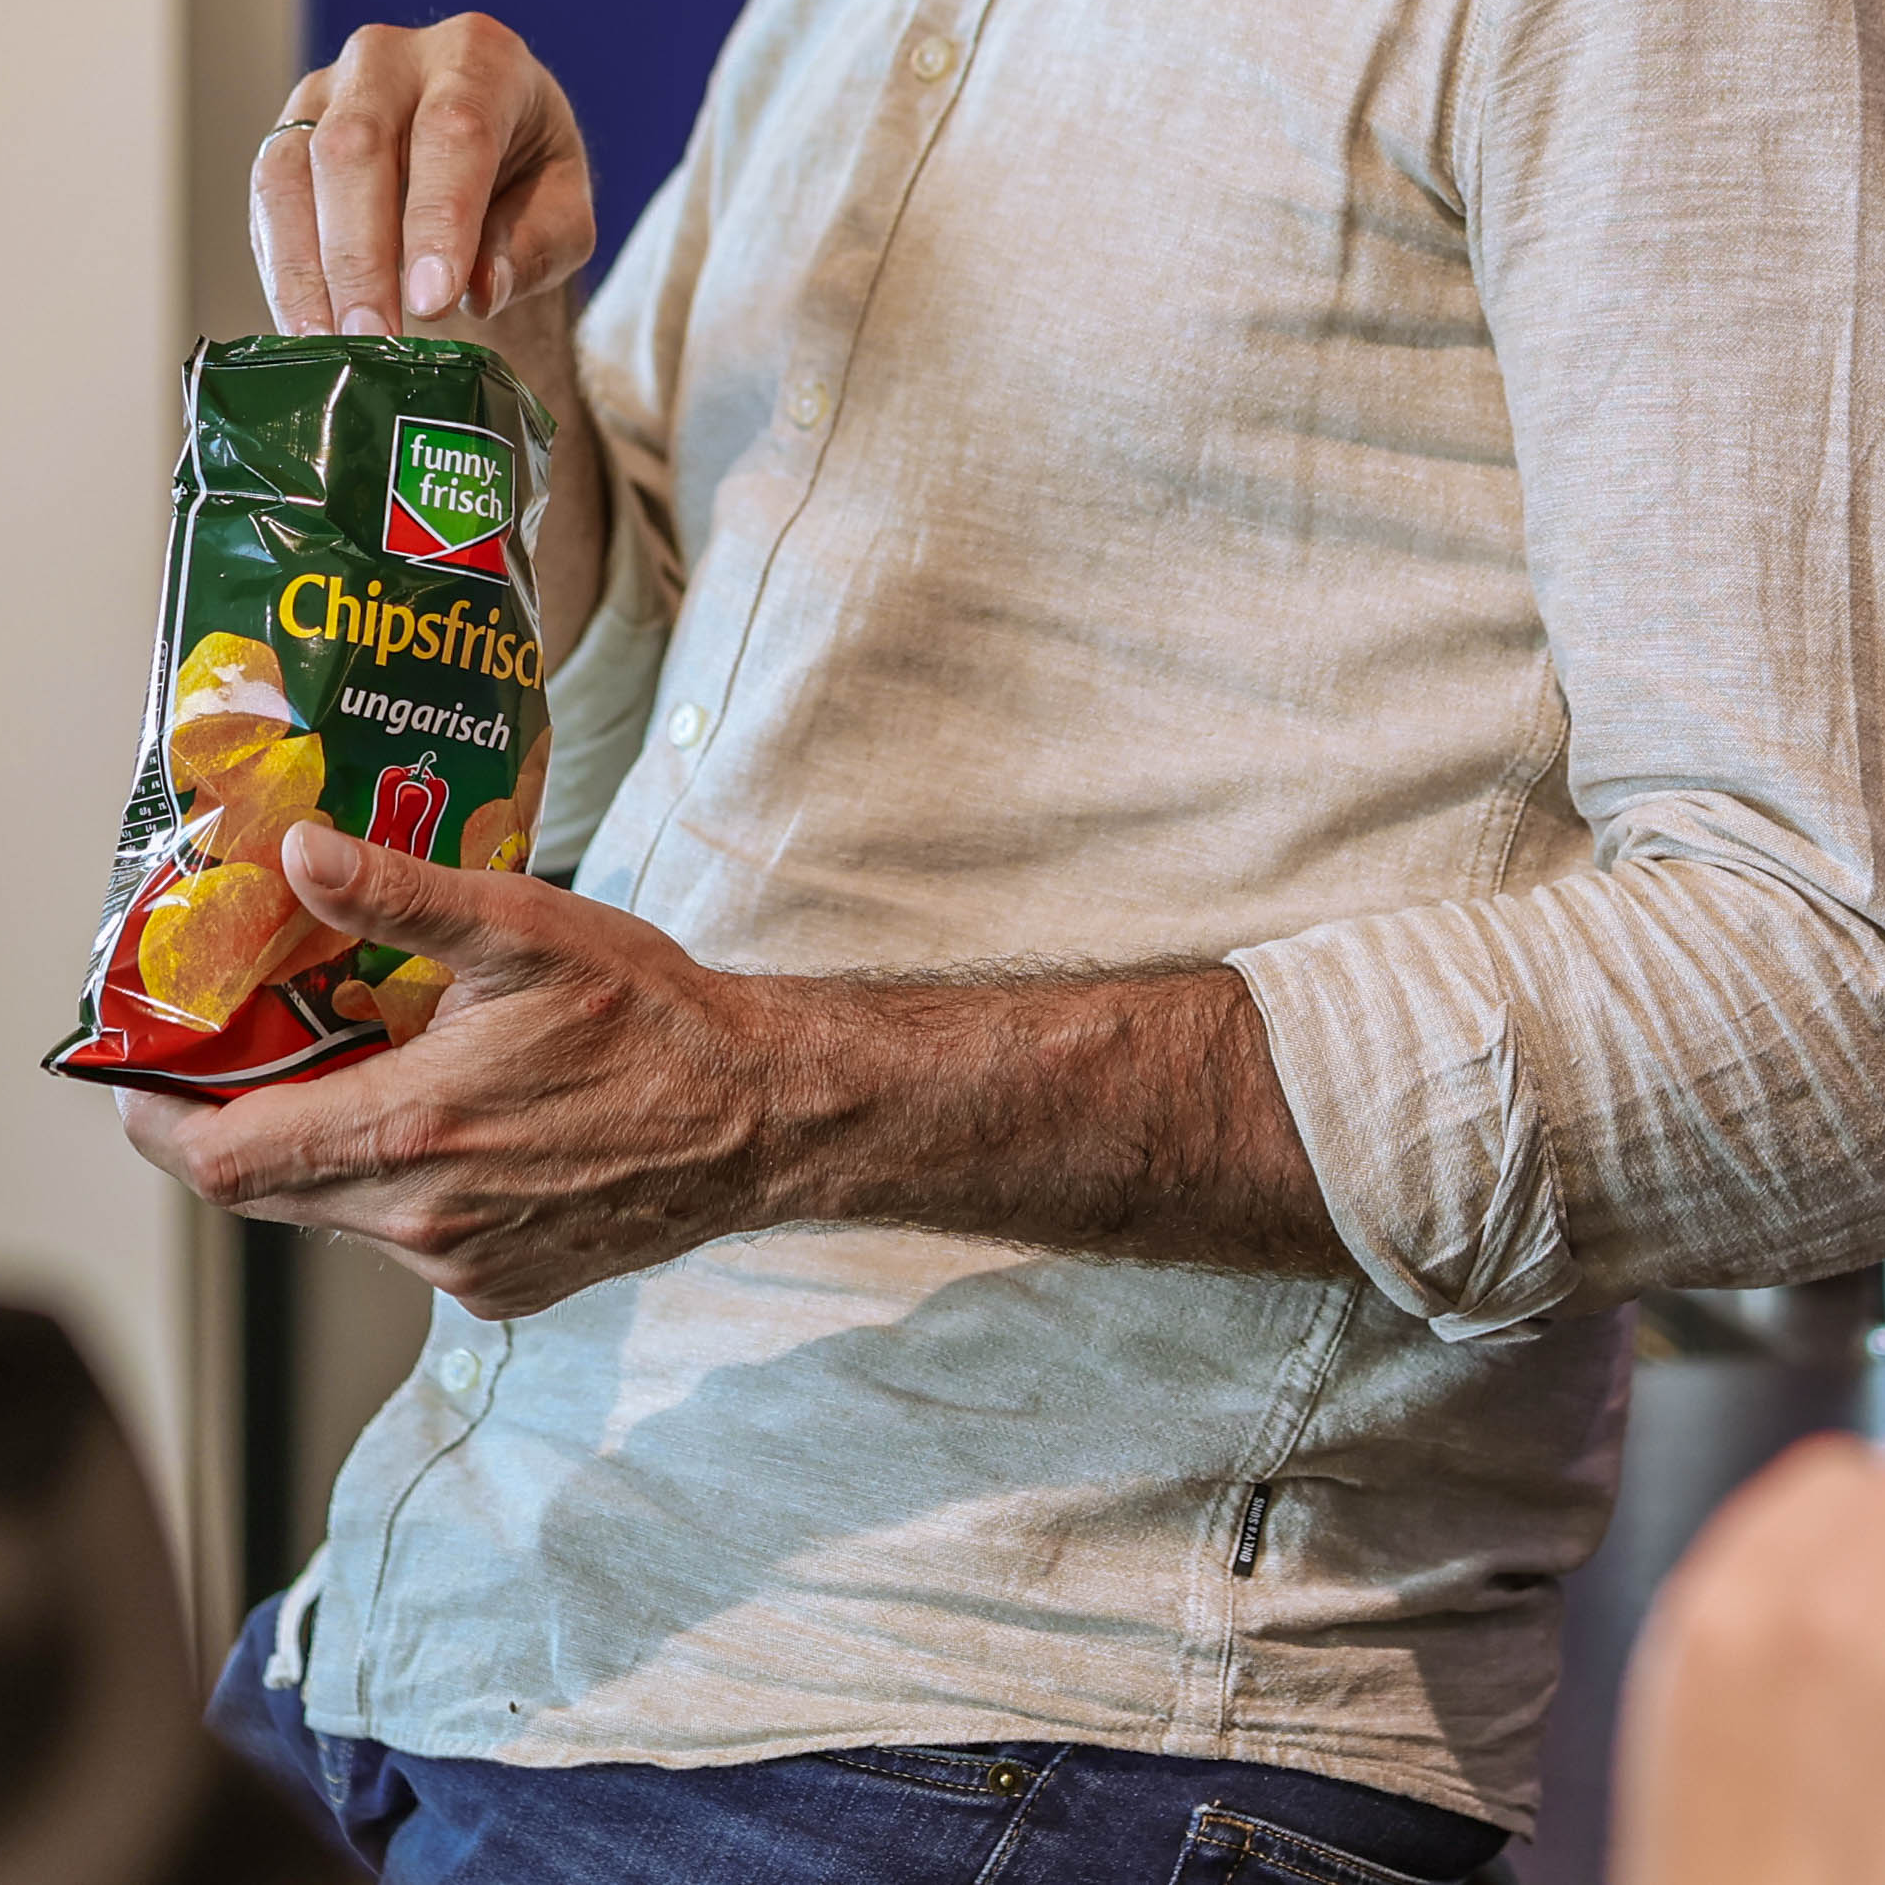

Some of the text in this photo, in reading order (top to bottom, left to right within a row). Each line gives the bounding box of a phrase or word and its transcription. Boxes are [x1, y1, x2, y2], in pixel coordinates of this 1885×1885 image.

[410, 433, 503, 487] funny-
[418, 472, 503, 522] frisch
[339, 686, 512, 752] ungarisch
[1239, 1532, 1256, 1562] ONLY
[1248, 1497, 1266, 1525] SONS
